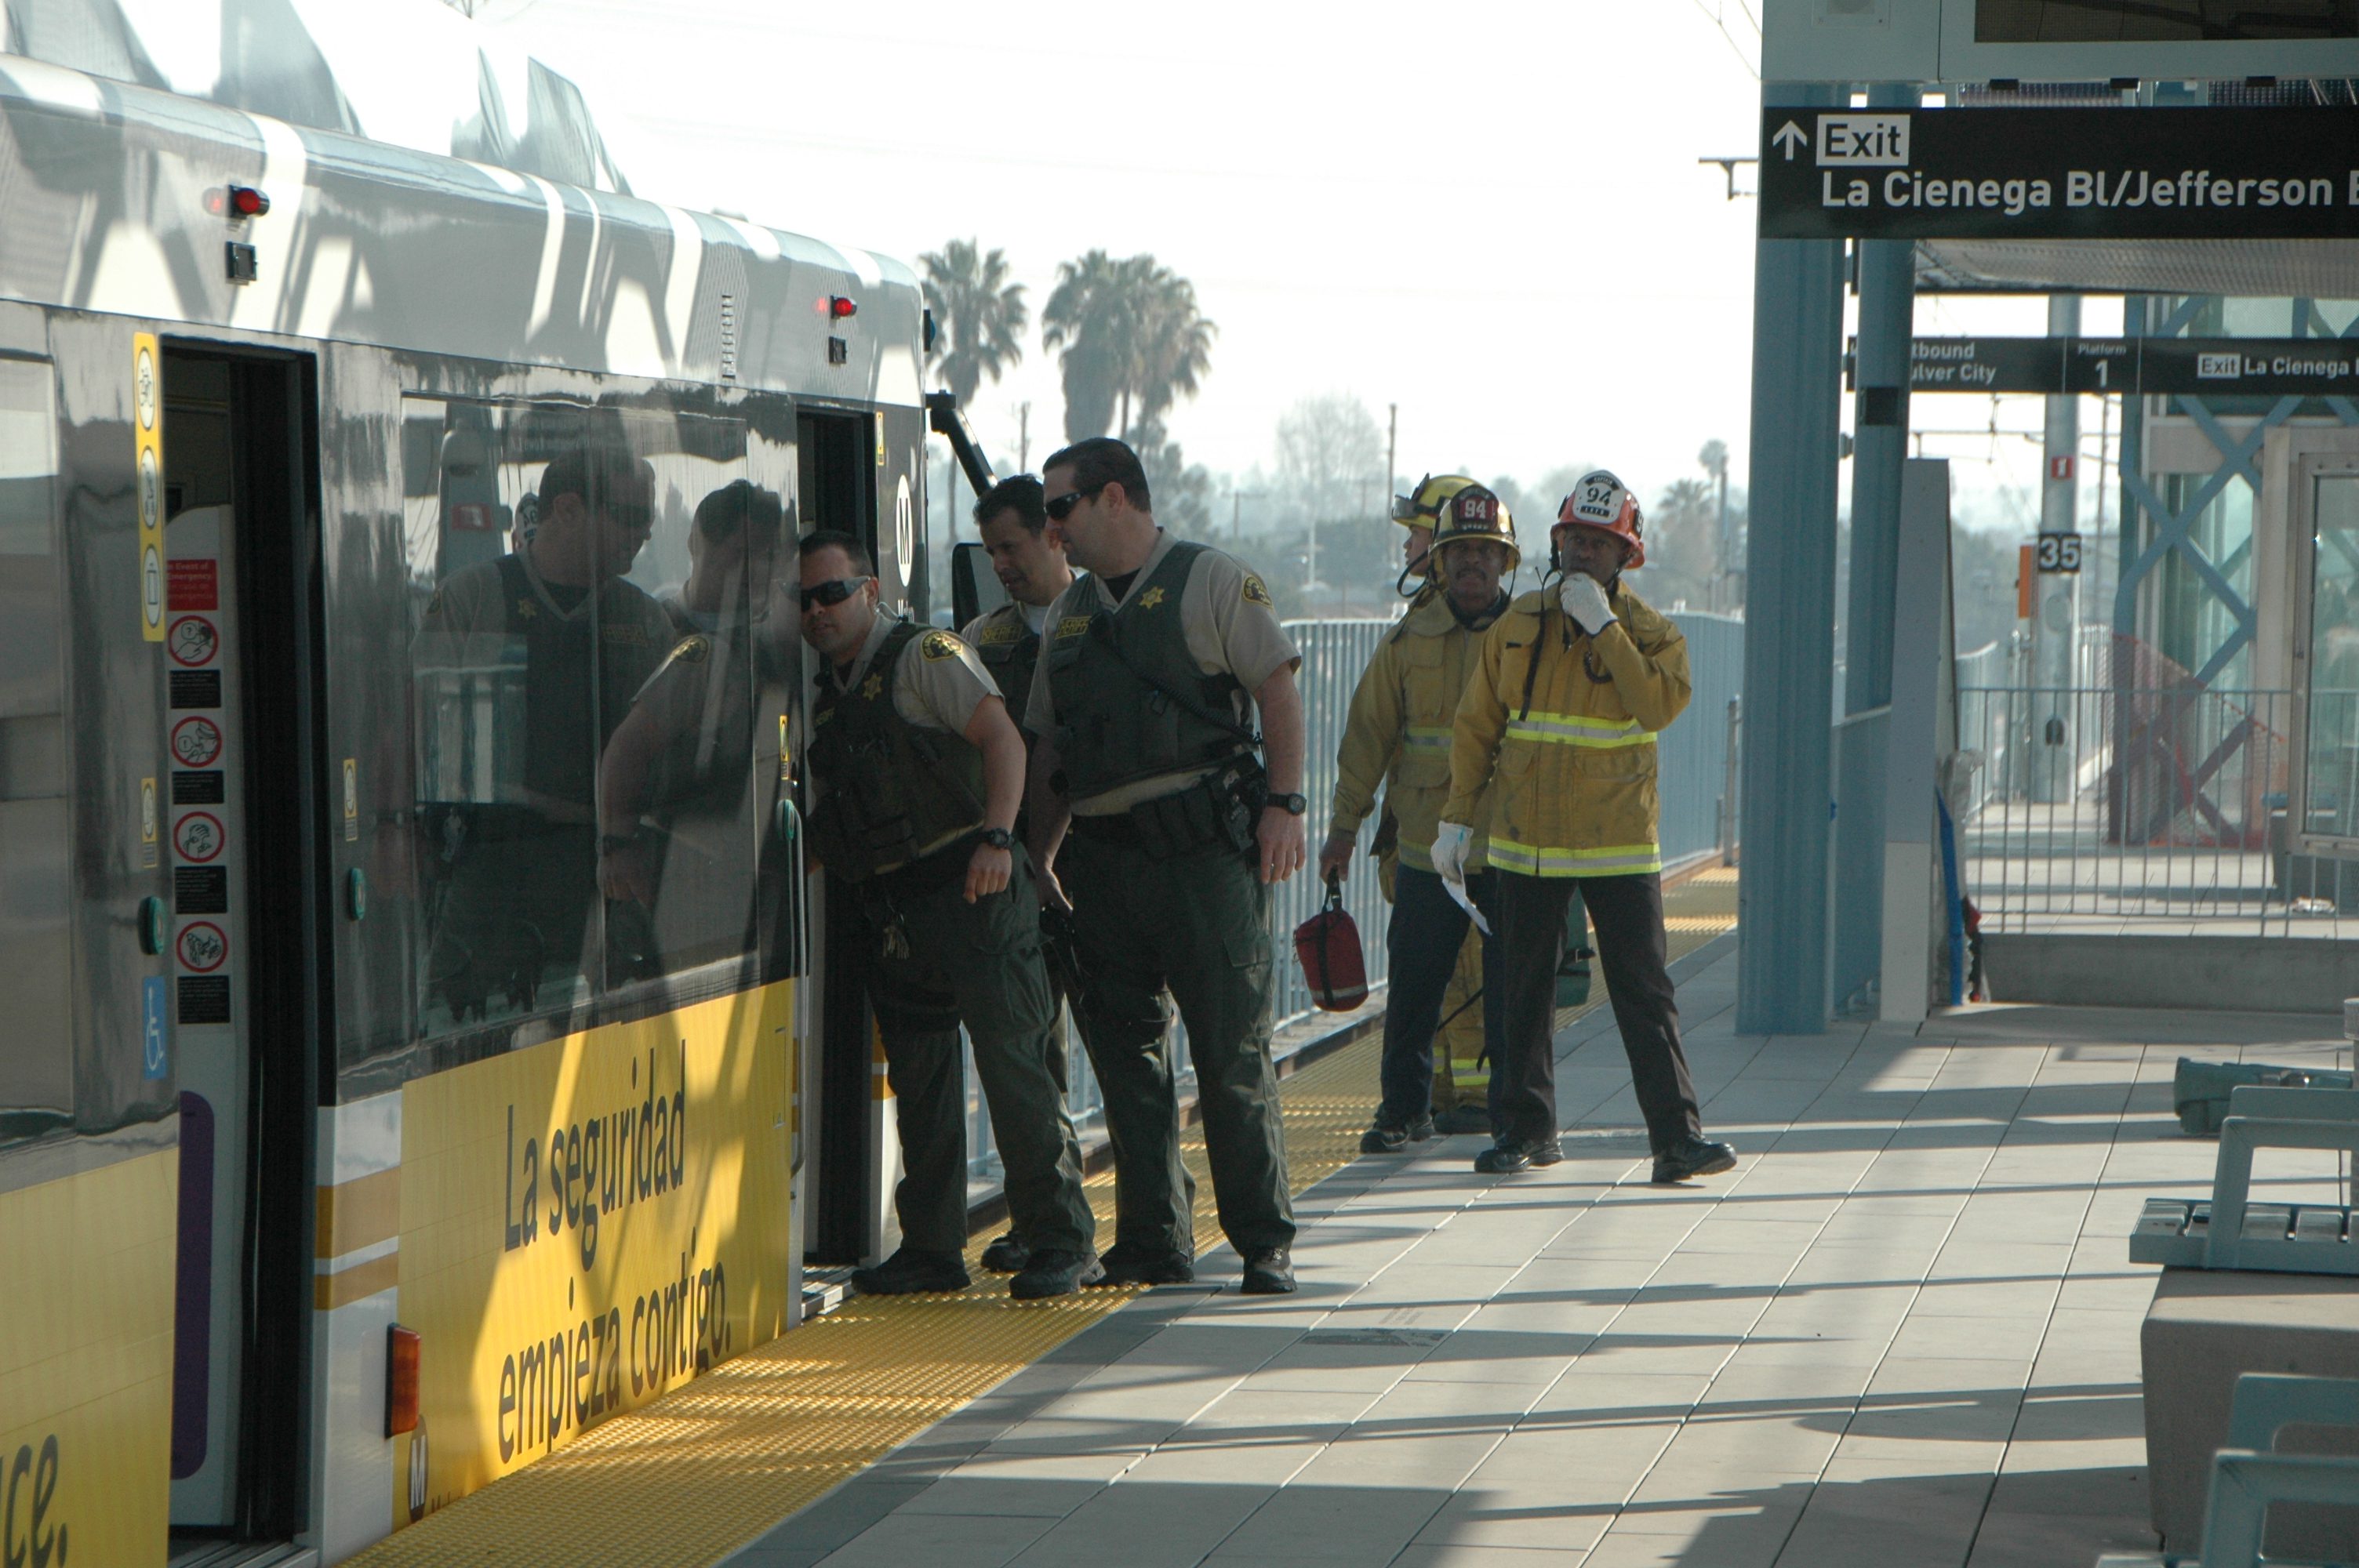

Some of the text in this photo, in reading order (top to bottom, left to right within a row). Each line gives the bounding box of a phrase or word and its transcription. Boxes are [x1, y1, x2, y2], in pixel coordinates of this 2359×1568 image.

[1825, 123, 1901, 157] Exit
[1823, 171, 1870, 207] La
[1884, 171, 2052, 216] Cienega
[2066, 170, 2333, 207] Bl/Jefferson
[1911, 341, 1975, 359] tbound
[2076, 343, 2127, 355] Platform
[1911, 364, 1997, 385] ulver City
[2095, 358, 2108, 388] 1
[2201, 358, 2237, 374] Exit
[2244, 357, 2267, 376] La
[2272, 356, 2350, 379] Cienega
[1464, 499, 1487, 519] 94
[1587, 487, 1612, 506] 94
[2040, 536, 2081, 568] 35
[505, 1039, 686, 1272] La seguridad
[496, 1226, 731, 1464] empieza contigo.
[0, 1433, 67, 1568] ce.
